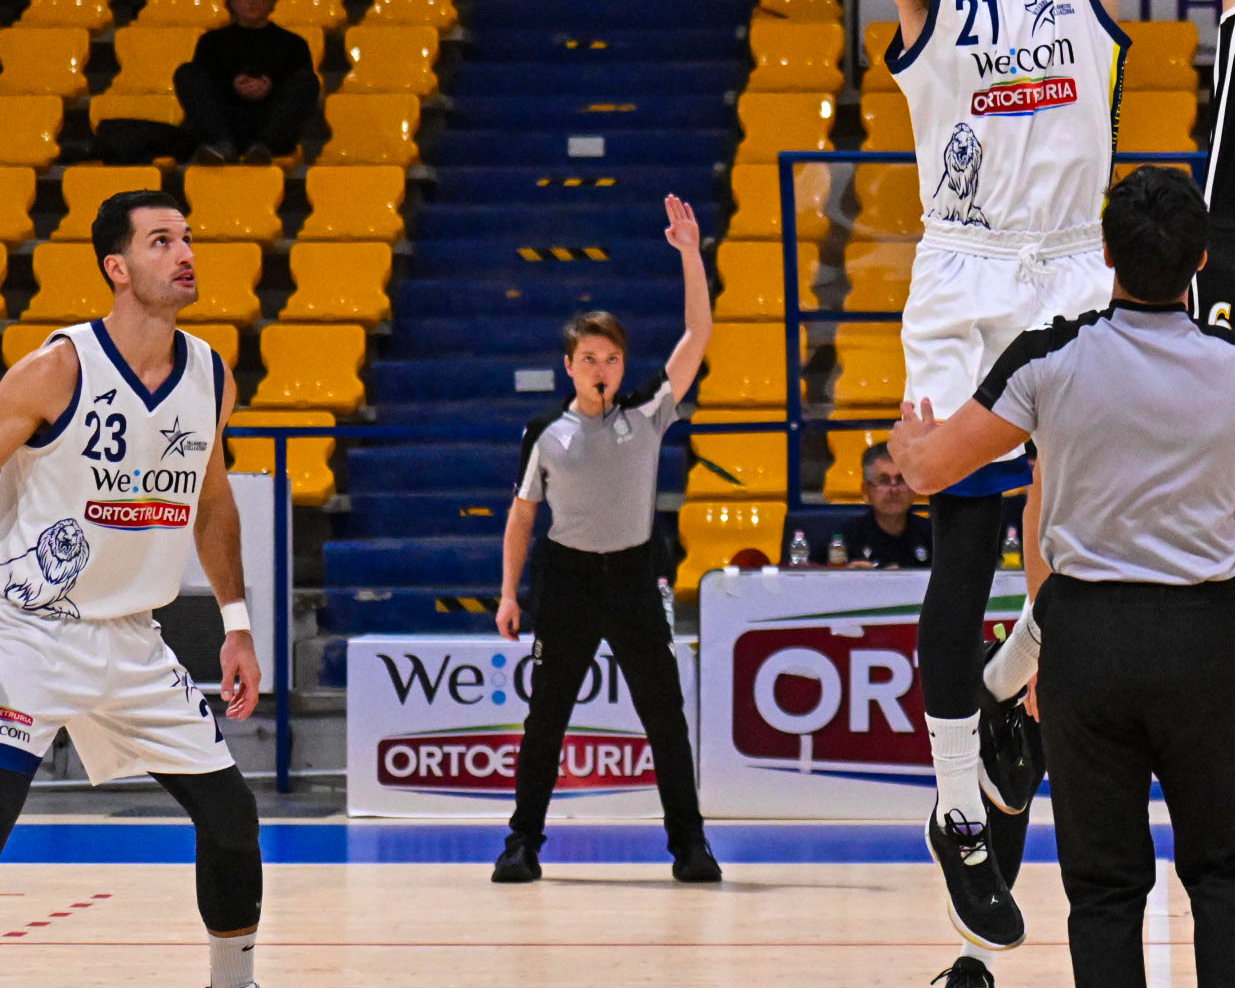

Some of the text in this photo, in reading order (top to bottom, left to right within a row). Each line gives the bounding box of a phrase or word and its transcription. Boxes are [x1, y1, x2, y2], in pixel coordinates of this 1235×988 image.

[971, 38, 1075, 79] We:com
[81, 410, 127, 463] 23
[90, 466, 197, 494] We:com
[88, 505, 188, 523] ORTOETRURIA
[0, 725, 30, 744] com
[384, 743, 657, 778] ORTOEURIA
